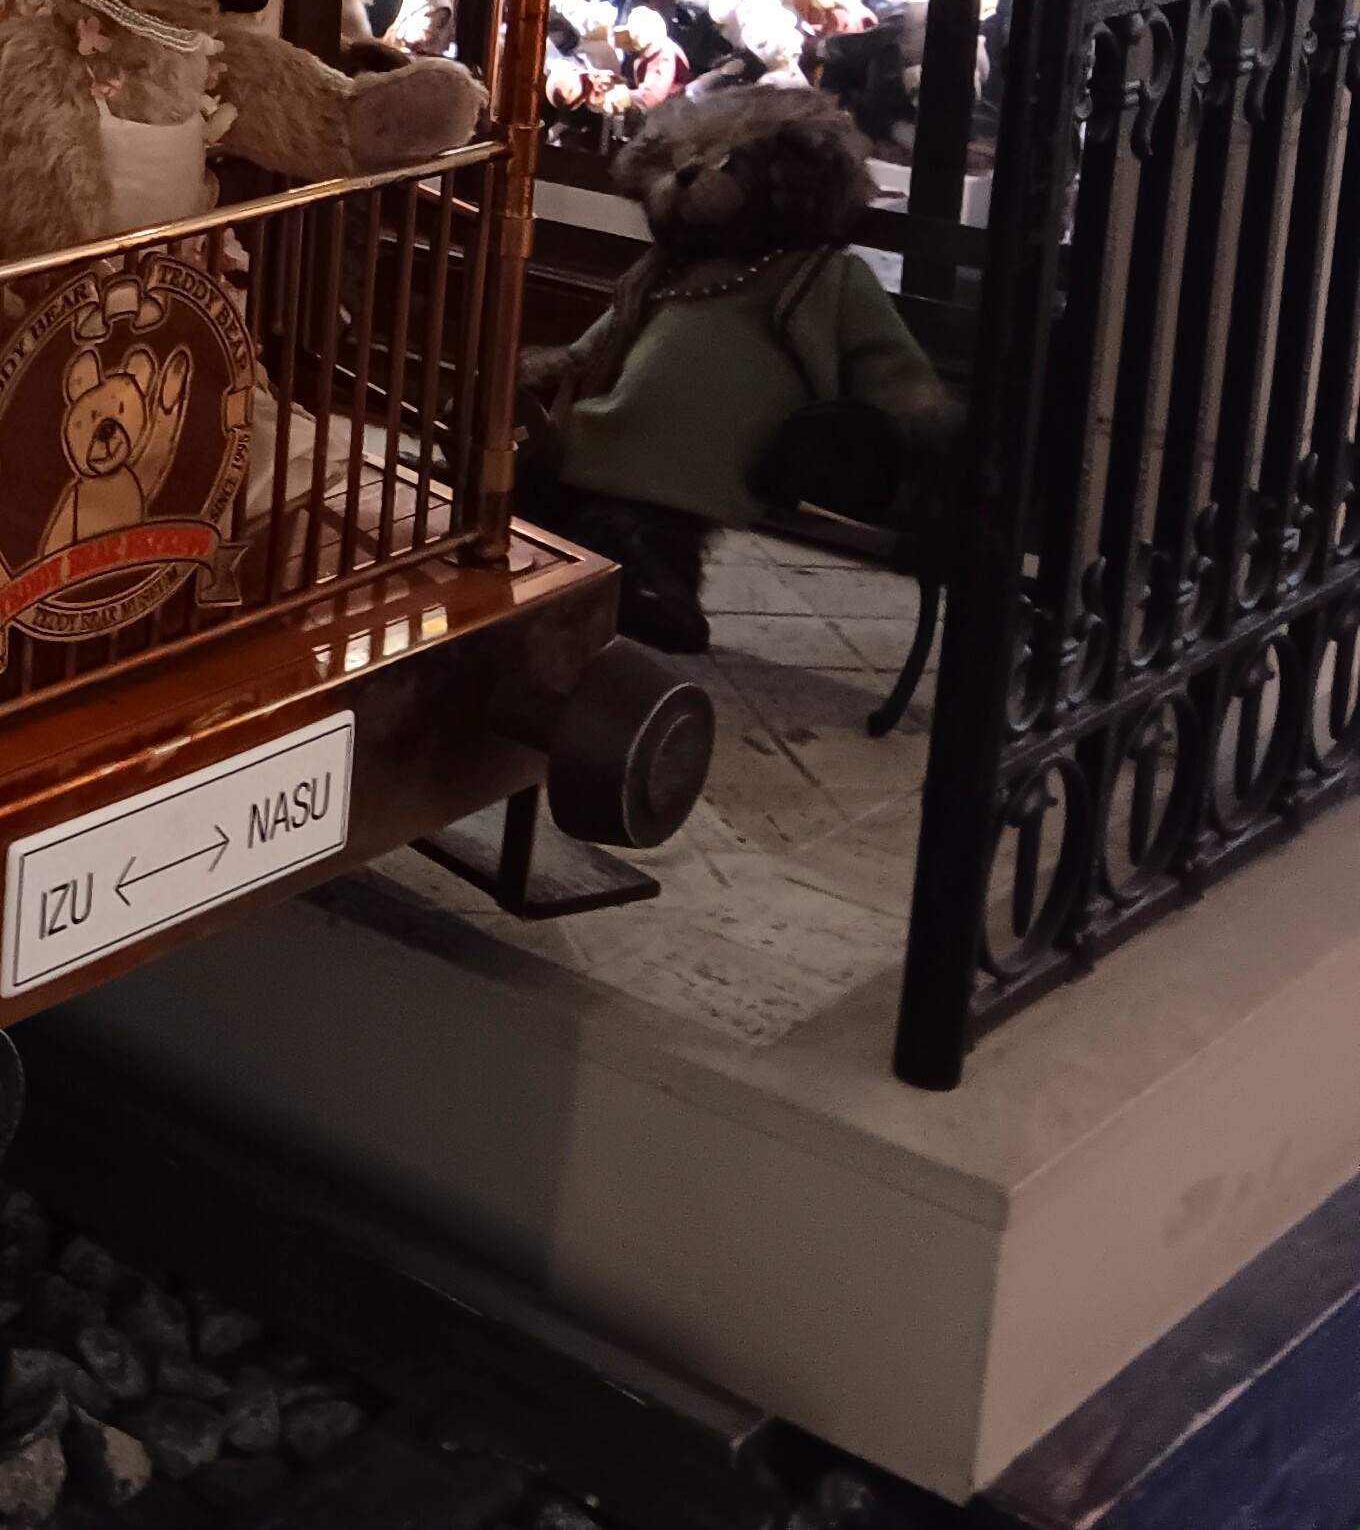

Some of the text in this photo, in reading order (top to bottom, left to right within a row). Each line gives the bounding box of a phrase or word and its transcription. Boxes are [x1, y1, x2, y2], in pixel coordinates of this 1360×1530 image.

[29, 282, 89, 341] BEAR
[159, 264, 220, 310] TEDDY
[38, 772, 332, 940] IZU NASU
